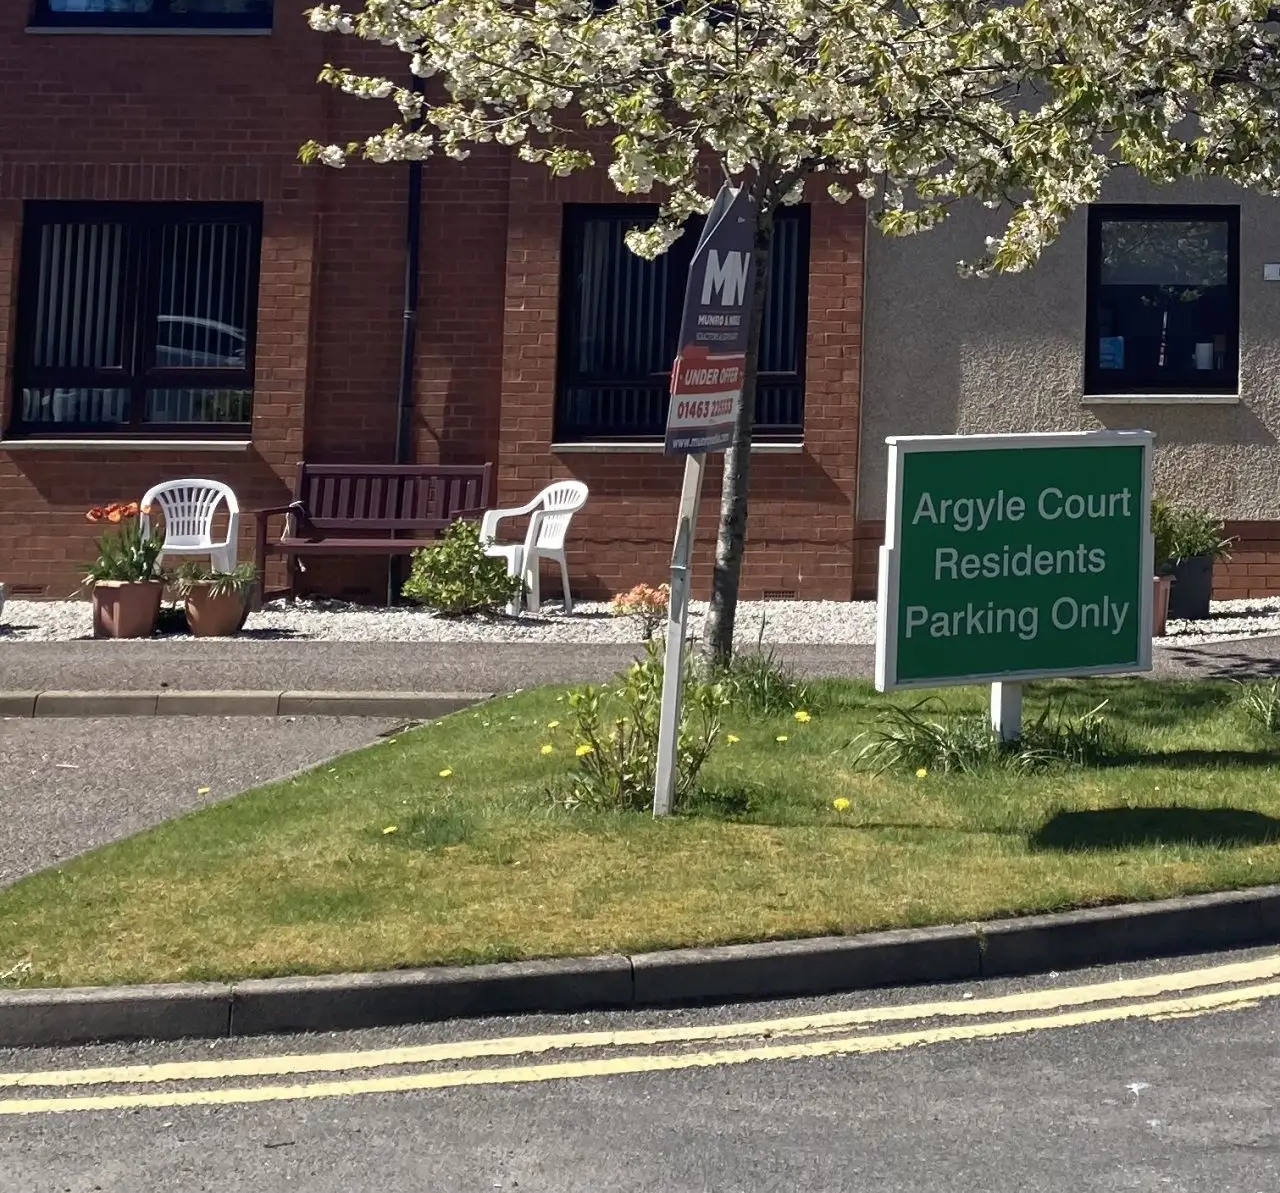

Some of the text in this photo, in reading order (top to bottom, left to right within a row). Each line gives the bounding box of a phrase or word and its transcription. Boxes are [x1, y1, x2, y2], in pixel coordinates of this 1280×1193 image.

[701, 249, 751, 306] MN
[697, 314, 723, 326] MUNRO
[684, 367, 740, 386] UNDER OFFER
[677, 400, 711, 420] 01463
[911, 487, 1132, 532] Argyle Court
[934, 543, 1106, 580] Residents
[905, 595, 1130, 641] Parking Only
